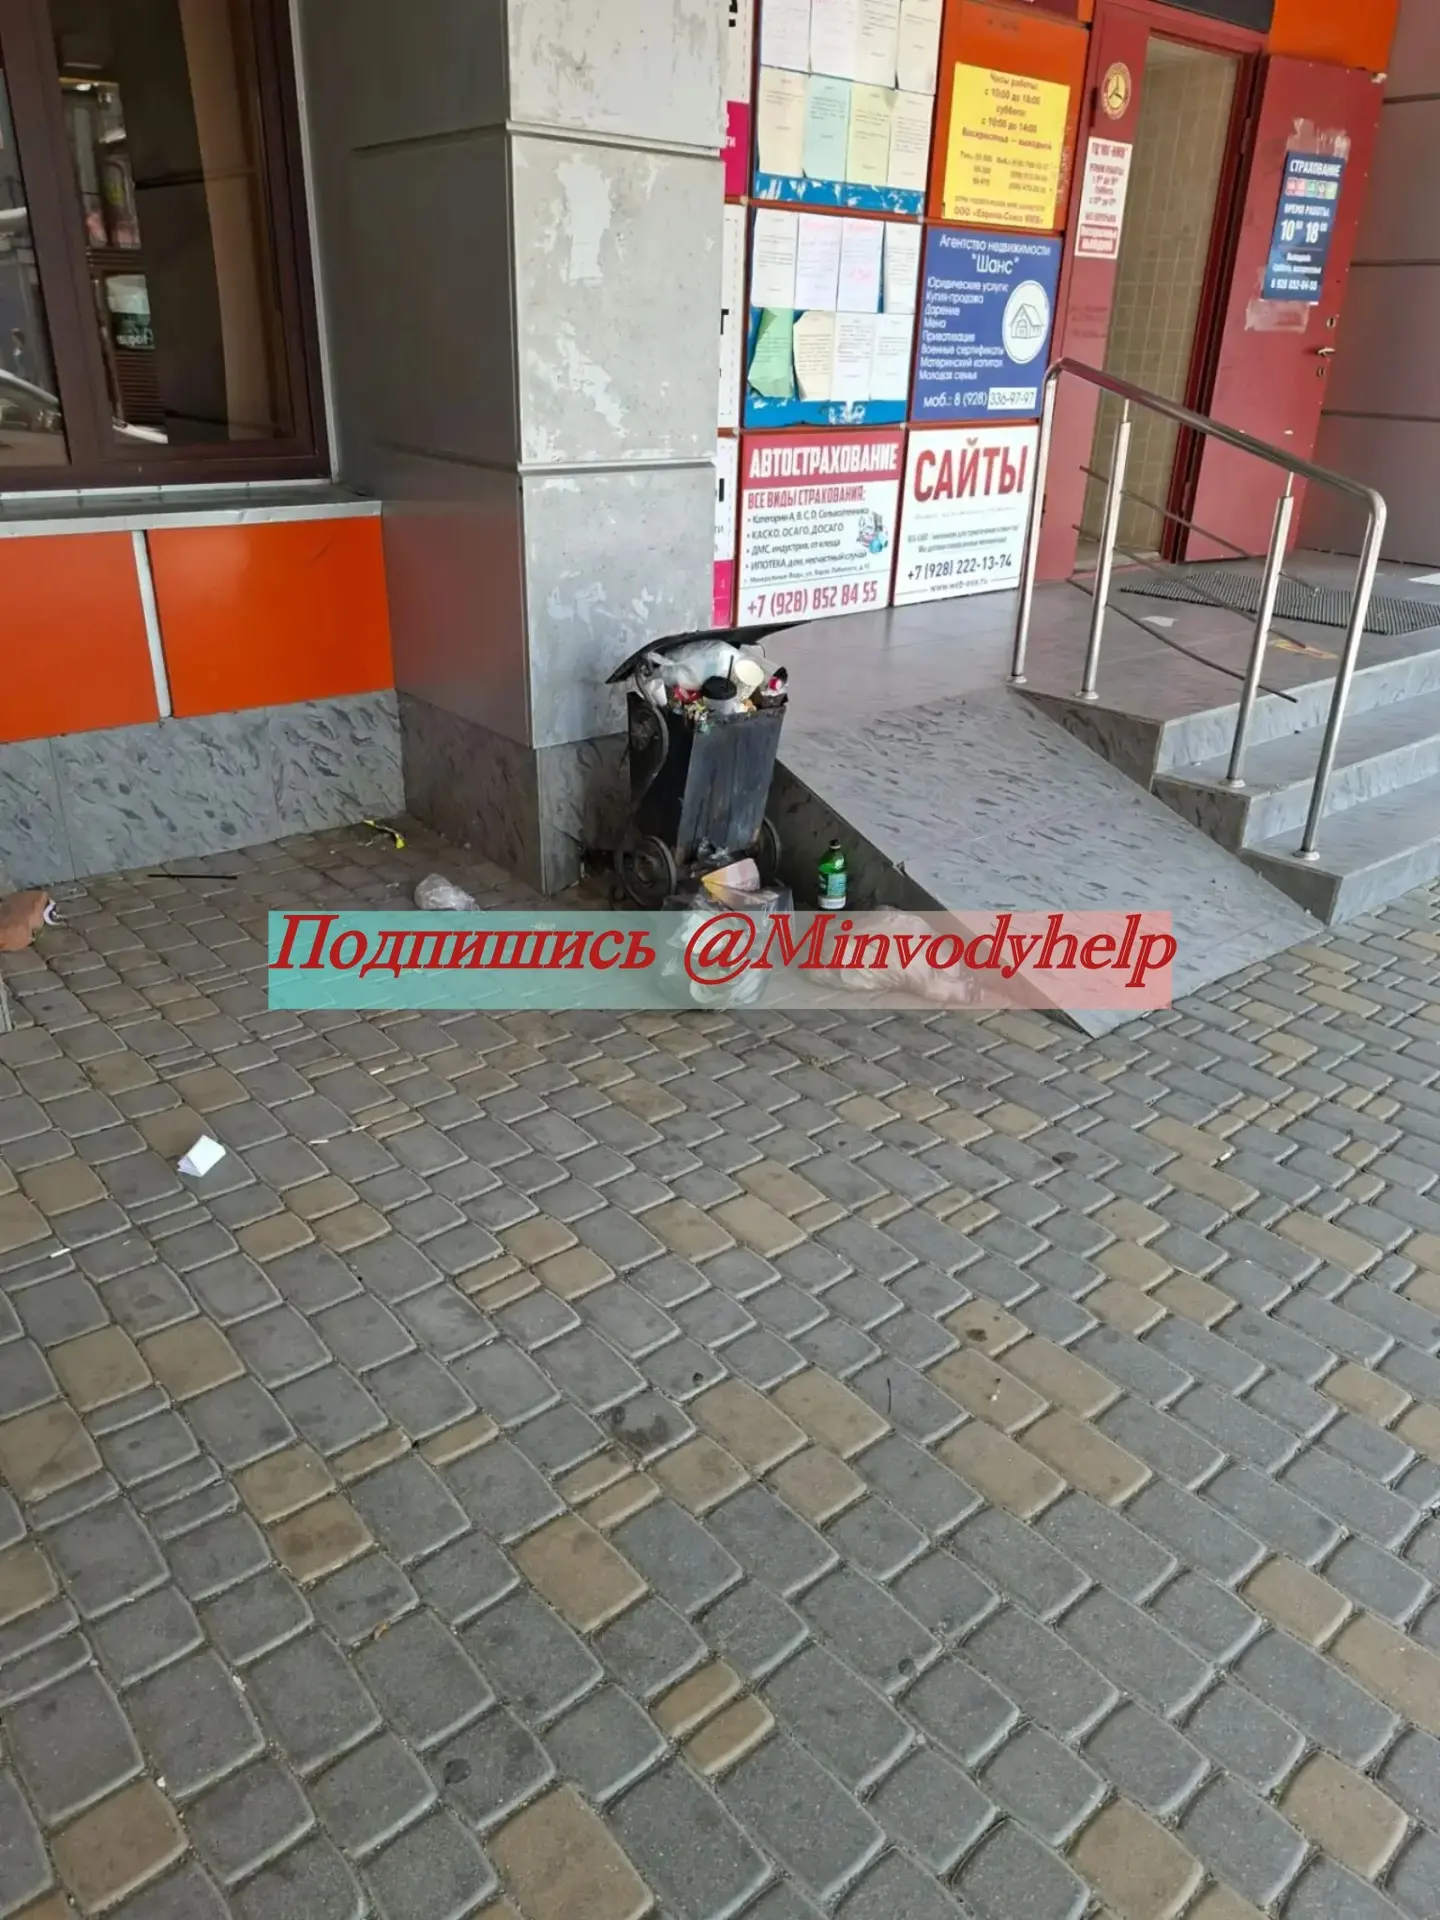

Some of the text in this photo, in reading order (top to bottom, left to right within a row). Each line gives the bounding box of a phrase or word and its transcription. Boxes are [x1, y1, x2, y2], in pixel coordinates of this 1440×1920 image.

[1289, 159, 1342, 178] СТРАХОВАНИЕ
[939, 233, 1051, 256] Агентство недвижимости
[928, 276, 981, 290] Юридические
[924, 303, 960, 317] Дарение
[923, 317, 946, 328] Мена
[920, 356, 973, 369] Материнский
[954, 391, 961, 406] 8
[963, 391, 987, 408] (928)
[749, 442, 899, 479] АВТОСТРАХОВАНИЕ
[914, 437, 1028, 503] САЙТЫ
[748, 492, 765, 509] ВСЕ
[767, 489, 797, 507] ВИДЫ
[810, 522, 844, 535] ДОСАГО
[908, 564, 922, 580] +7
[924, 559, 954, 581] (928)
[747, 580, 878, 619] +7 (928) 852 84 55
